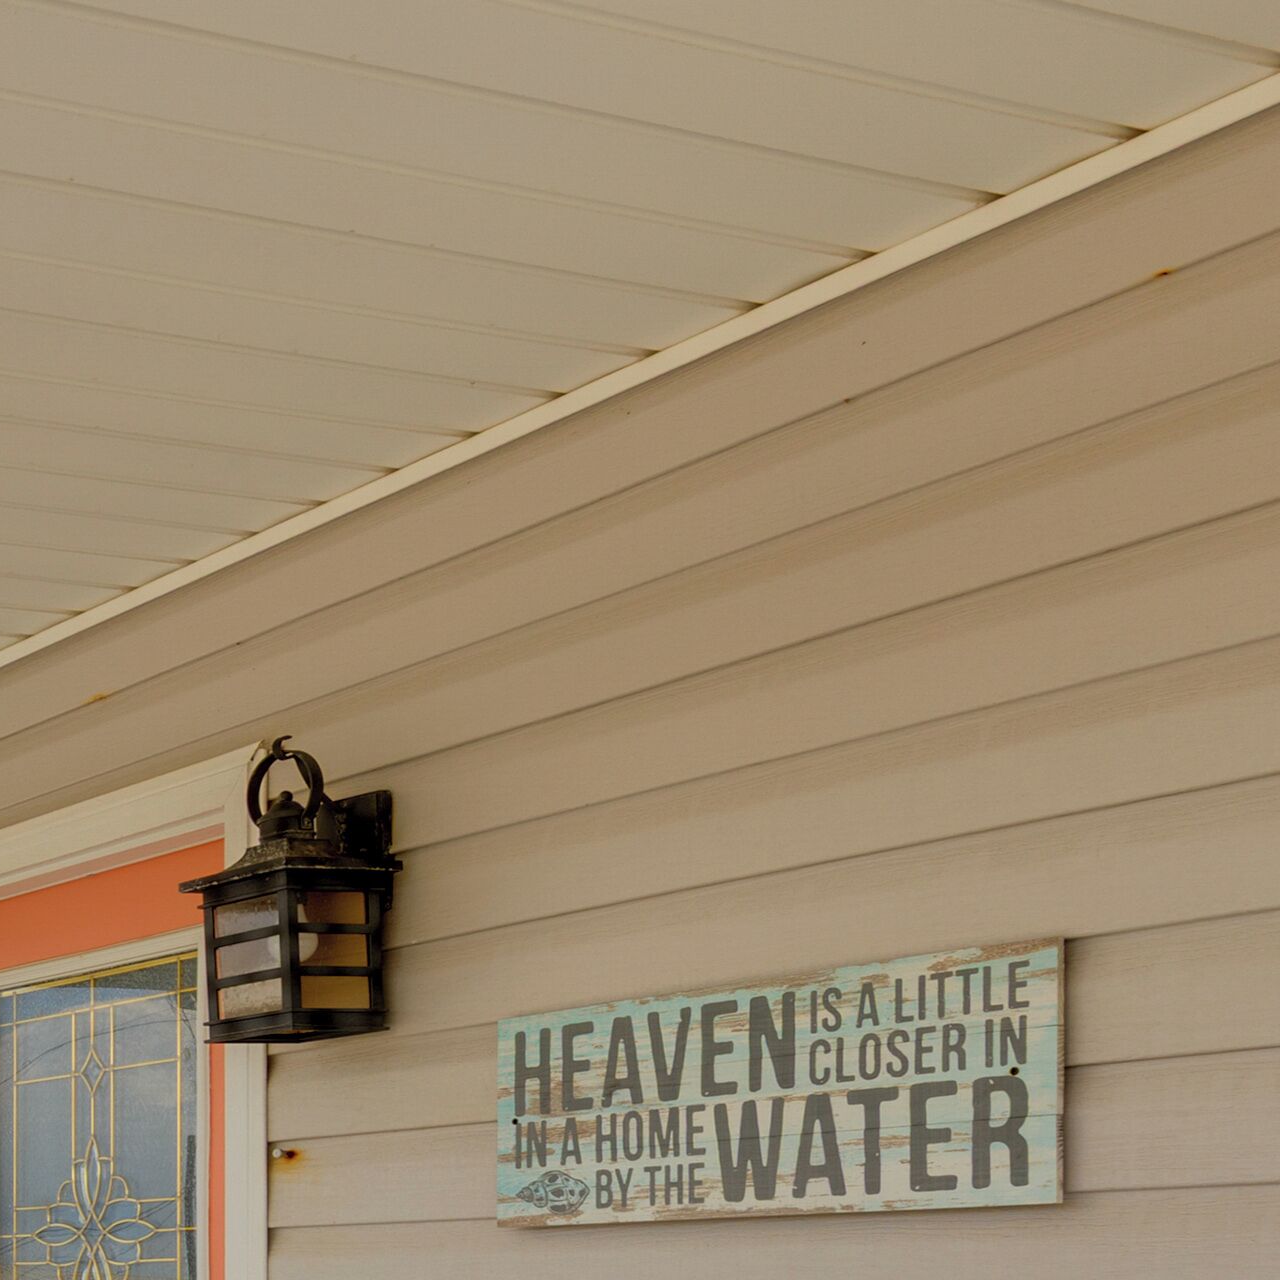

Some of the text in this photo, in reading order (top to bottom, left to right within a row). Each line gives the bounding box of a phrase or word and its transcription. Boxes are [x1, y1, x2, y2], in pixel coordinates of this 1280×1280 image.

[810, 960, 1029, 1033] IS A LITTLE
[514, 991, 795, 1117] HEAVEN
[810, 1015, 1027, 1086] CLOSER IN
[514, 1104, 706, 1169] IN A HOME
[714, 1067, 1029, 1202] WATER
[596, 1163, 705, 1209] BY THE
